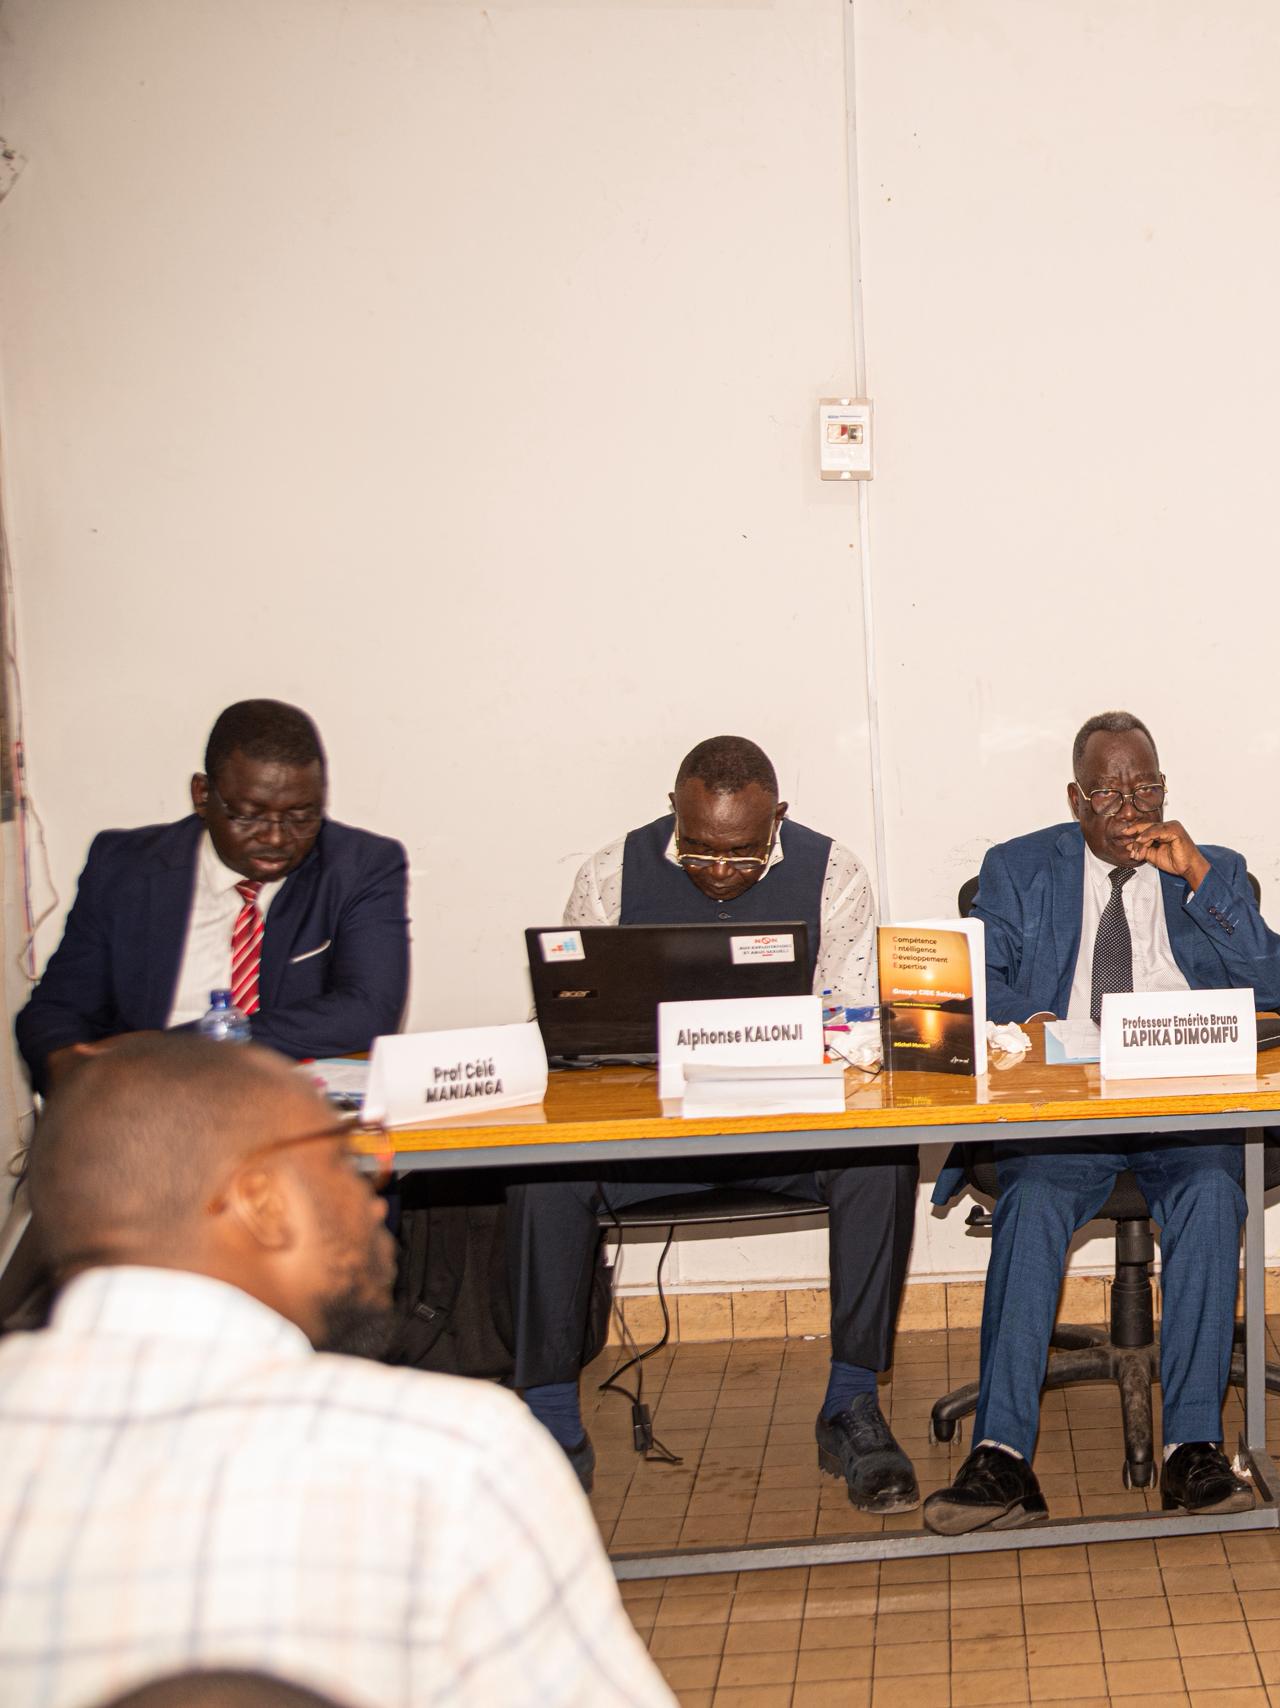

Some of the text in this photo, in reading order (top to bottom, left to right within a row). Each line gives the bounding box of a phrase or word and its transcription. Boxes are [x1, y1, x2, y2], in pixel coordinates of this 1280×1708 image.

[559, 990, 592, 998] acer
[1122, 1013, 1238, 1029] Professeur Emérite Bruno
[677, 1023, 803, 1051] Alphonse KALONJI
[1122, 1026, 1239, 1048] LAPIKA DIMOMFU
[433, 1057, 496, 1083] Prof Célé
[425, 1079, 504, 1103] MANIANGA
